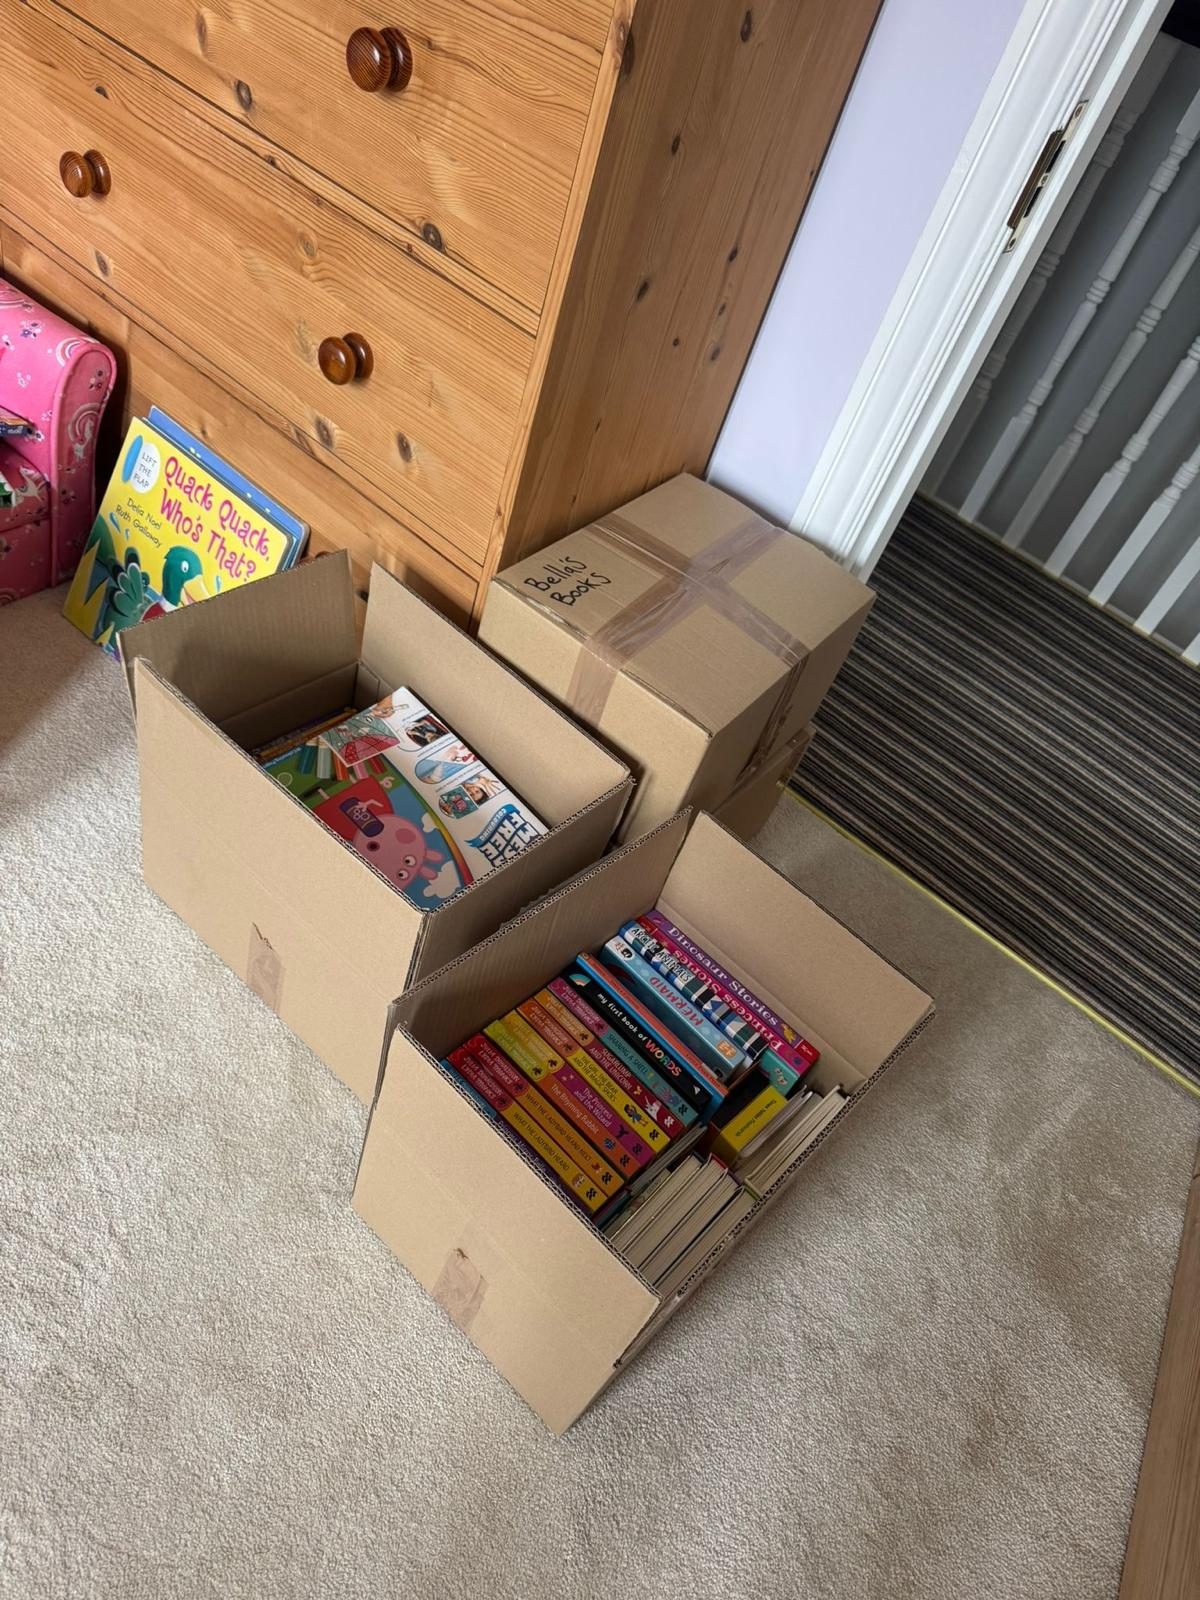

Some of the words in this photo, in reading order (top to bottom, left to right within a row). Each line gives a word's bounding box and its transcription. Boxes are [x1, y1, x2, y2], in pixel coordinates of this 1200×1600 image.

[133, 473, 150, 488] FLAP
[138, 463, 153, 476] THE
[141, 452, 158, 467] LIFT
[164, 456, 213, 512] Quack
[115, 505, 131, 522] Ruth
[132, 518, 162, 548] Galloway
[160, 487, 204, 543] Who's
[206, 530, 257, 582] That?
[524, 556, 587, 592] Bella's
[478, 807, 508, 841] COLOURING
[478, 811, 523, 860] FREE
[630, 925, 659, 953] ARCTIC
[655, 947, 692, 983] ANIMALS
[667, 925, 728, 981] Dinosaur
[729, 979, 778, 1027] Stories
[672, 948, 721, 995] Stories
[650, 975, 703, 1027] MERMAID
[724, 993, 782, 1050] Princess
[595, 991, 608, 1005] my
[606, 1000, 624, 1018] first
[620, 1014, 639, 1034] book
[636, 1030, 648, 1042] of
[645, 1039, 681, 1077] WORDS
[606, 1032, 631, 1057] SHARING
[627, 1053, 635, 1061] A
[632, 1058, 648, 1074] SHELL
[588, 1046, 602, 1060] AND
[600, 1058, 611, 1069] THE
[608, 1066, 632, 1090] UNICORN
[600, 1046, 632, 1079] SUGARLUMP
[550, 1083, 563, 1096] The
[558, 1092, 584, 1118] Rhyming
[580, 1114, 600, 1134] Rabbit
[573, 1088, 585, 1101] and
[582, 1098, 594, 1110] the
[591, 1107, 611, 1127] Wizard
[582, 1087, 594, 1099] The
[590, 1096, 613, 1119] Princess
[511, 1111, 526, 1127] WHAT
[523, 1124, 535, 1136] THE
[551, 1153, 570, 1172] HEARD
